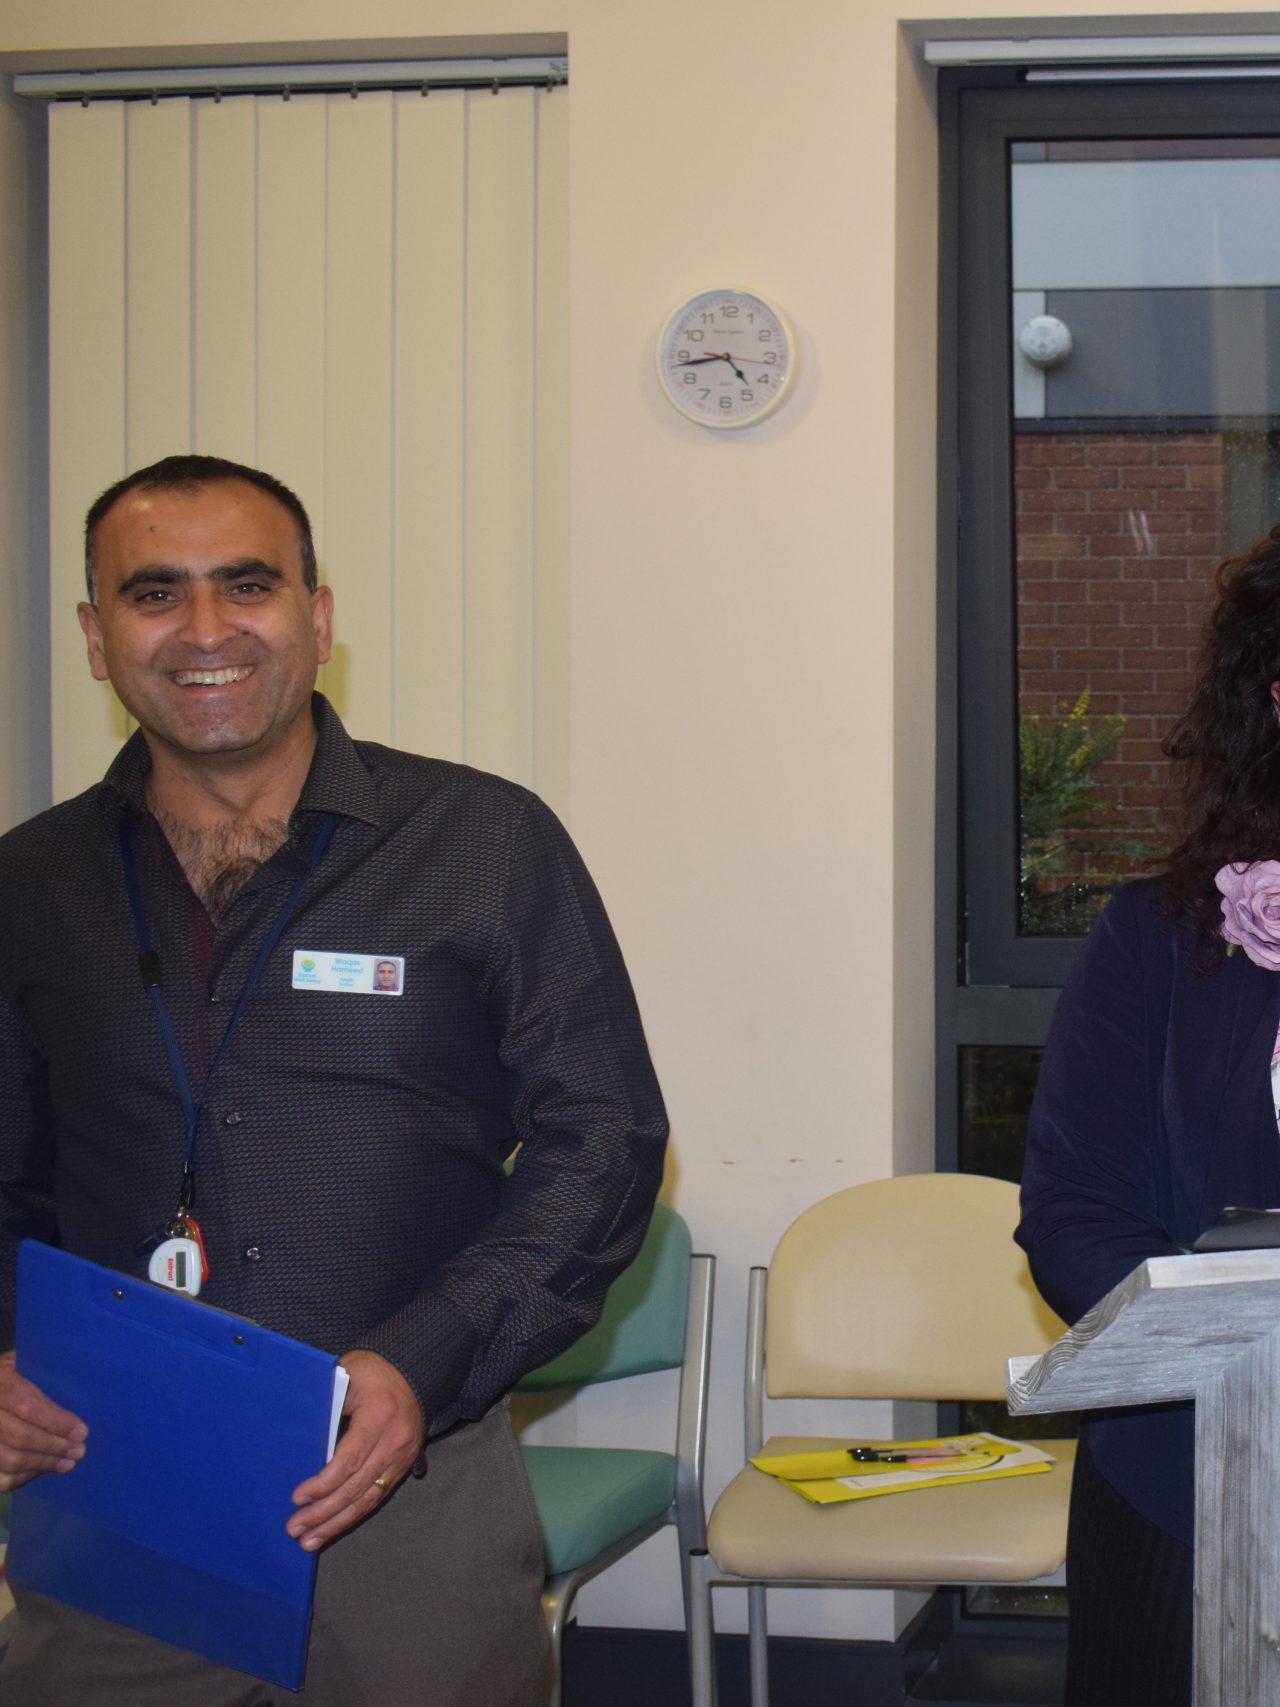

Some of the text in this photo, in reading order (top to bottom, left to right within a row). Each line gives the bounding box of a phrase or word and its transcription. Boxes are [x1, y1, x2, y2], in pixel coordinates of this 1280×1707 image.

[720, 306, 739, 318] 12
[700, 313, 714, 324] 11
[746, 313, 754, 324] 1
[684, 329, 704, 342] 10
[758, 329, 771, 342] 2
[678, 350, 690, 363] 9
[763, 352, 777, 364] 3
[683, 372, 697, 385] 8
[757, 373, 769, 385] 4
[698, 388, 711, 400] 7
[740, 389, 754, 401] 5
[719, 396, 732, 409] 6
